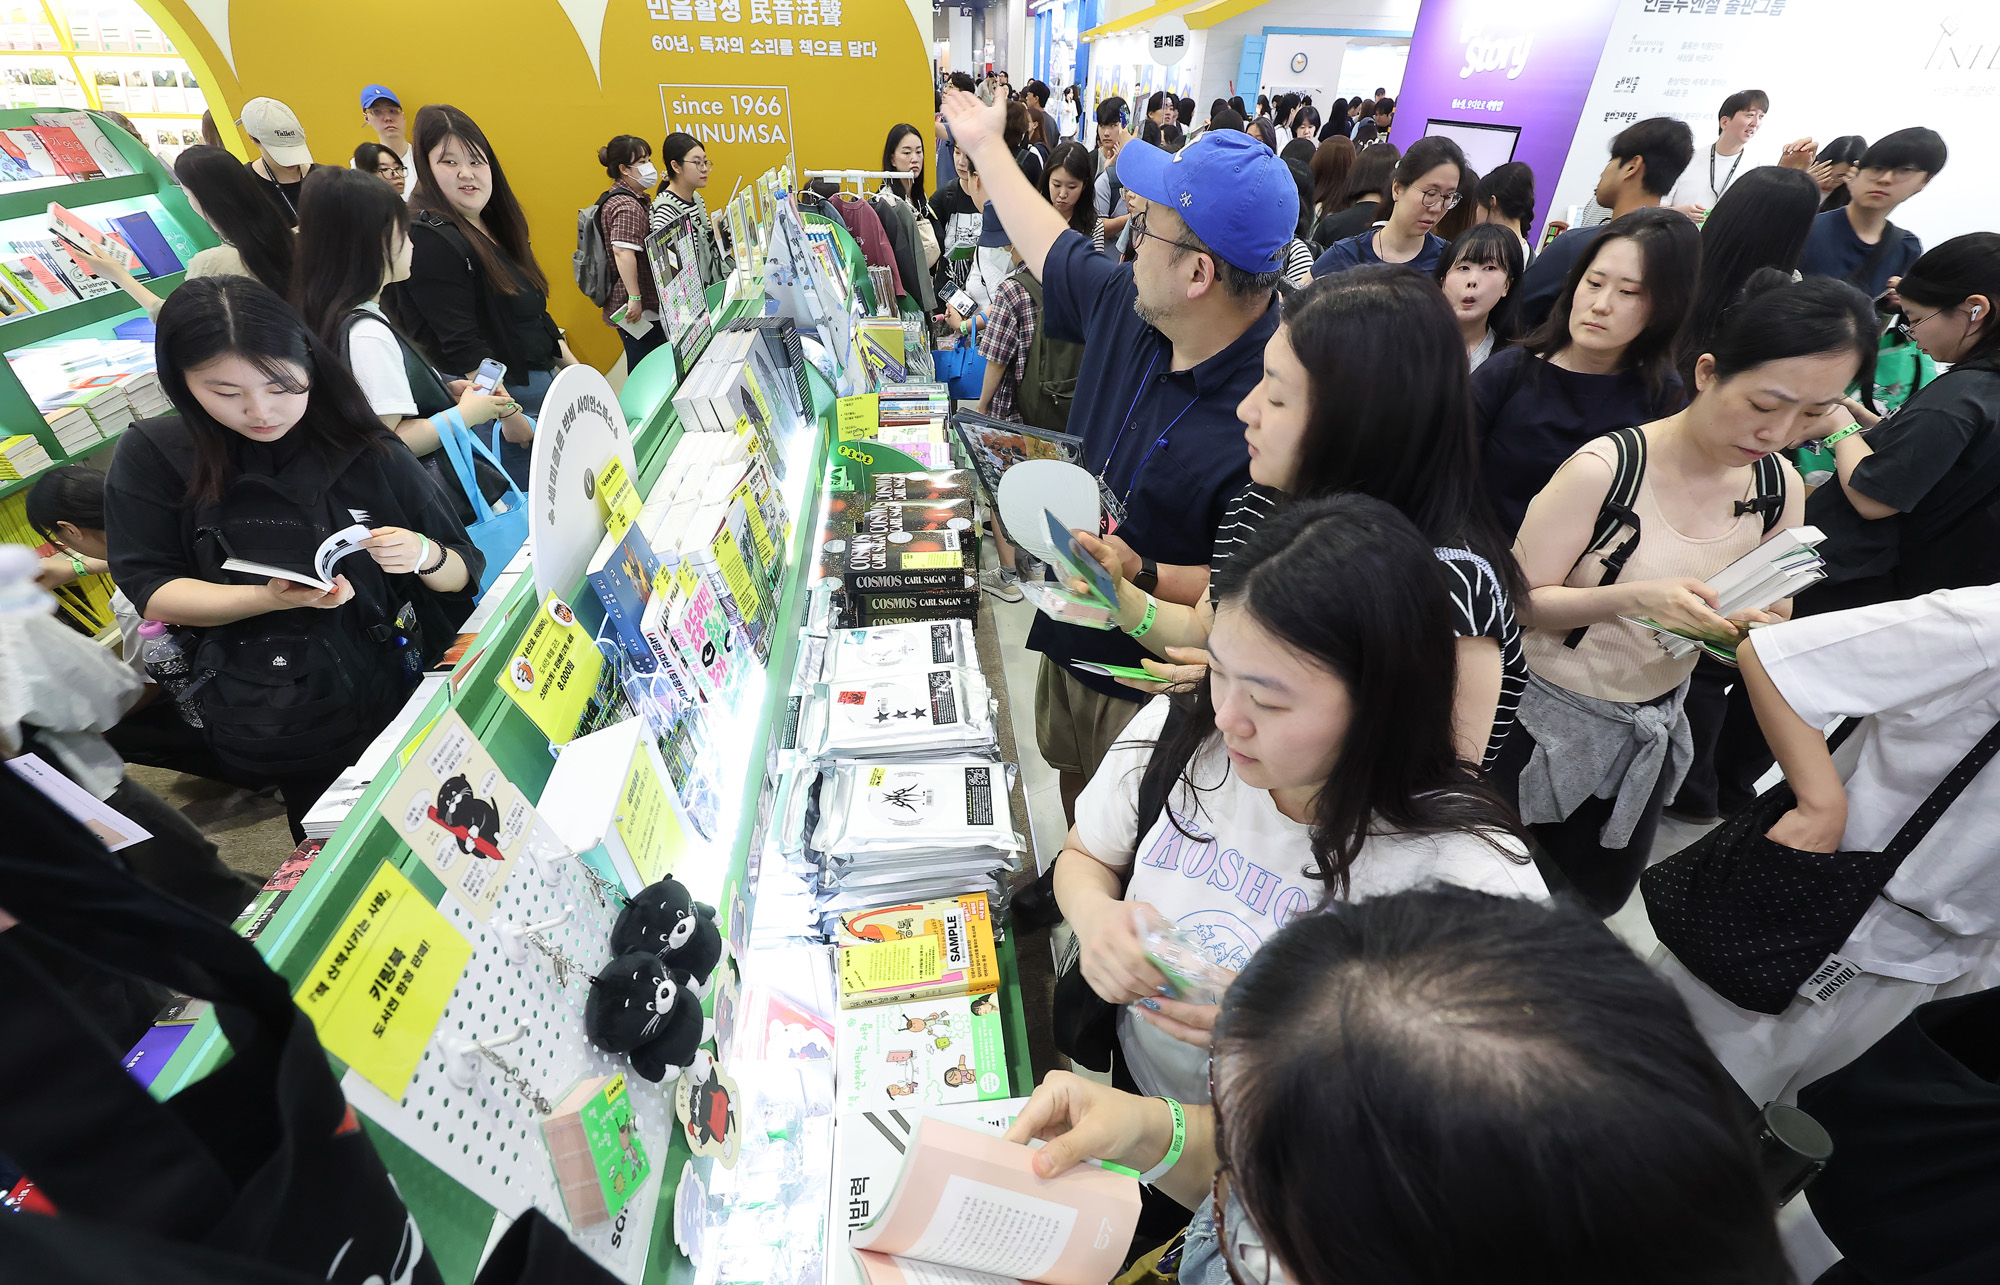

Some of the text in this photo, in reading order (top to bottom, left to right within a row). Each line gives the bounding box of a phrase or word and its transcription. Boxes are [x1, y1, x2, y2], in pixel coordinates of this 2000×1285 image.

[651, 34, 878, 58] 60년, 독자의 소리를 책으로 담다
[1153, 35, 1185, 48] 결제줄
[672, 93, 783, 117] since 1966
[561, 405, 578, 434] 반비
[869, 501, 888, 533] COSMOS
[850, 534, 871, 570] COSMOS
[871, 552, 887, 570] CARL
[856, 575, 947, 589] COSMOS CARL SAGAN
[871, 597, 961, 610] COSMOS CARL SAGAN
[557, 661, 575, 691] 8,000원
[308, 889, 393, 1004] 『책 산책시키는 사람』
[946, 915, 961, 963] SAMPLE
[368, 946, 408, 1002] 키링북
[373, 939, 431, 1039] 도서전 한정 판매!
[854, 1044, 868, 1092] 산책시키는
[861, 1022, 873, 1041] 사람
[598, 1132, 611, 1150] 사람
